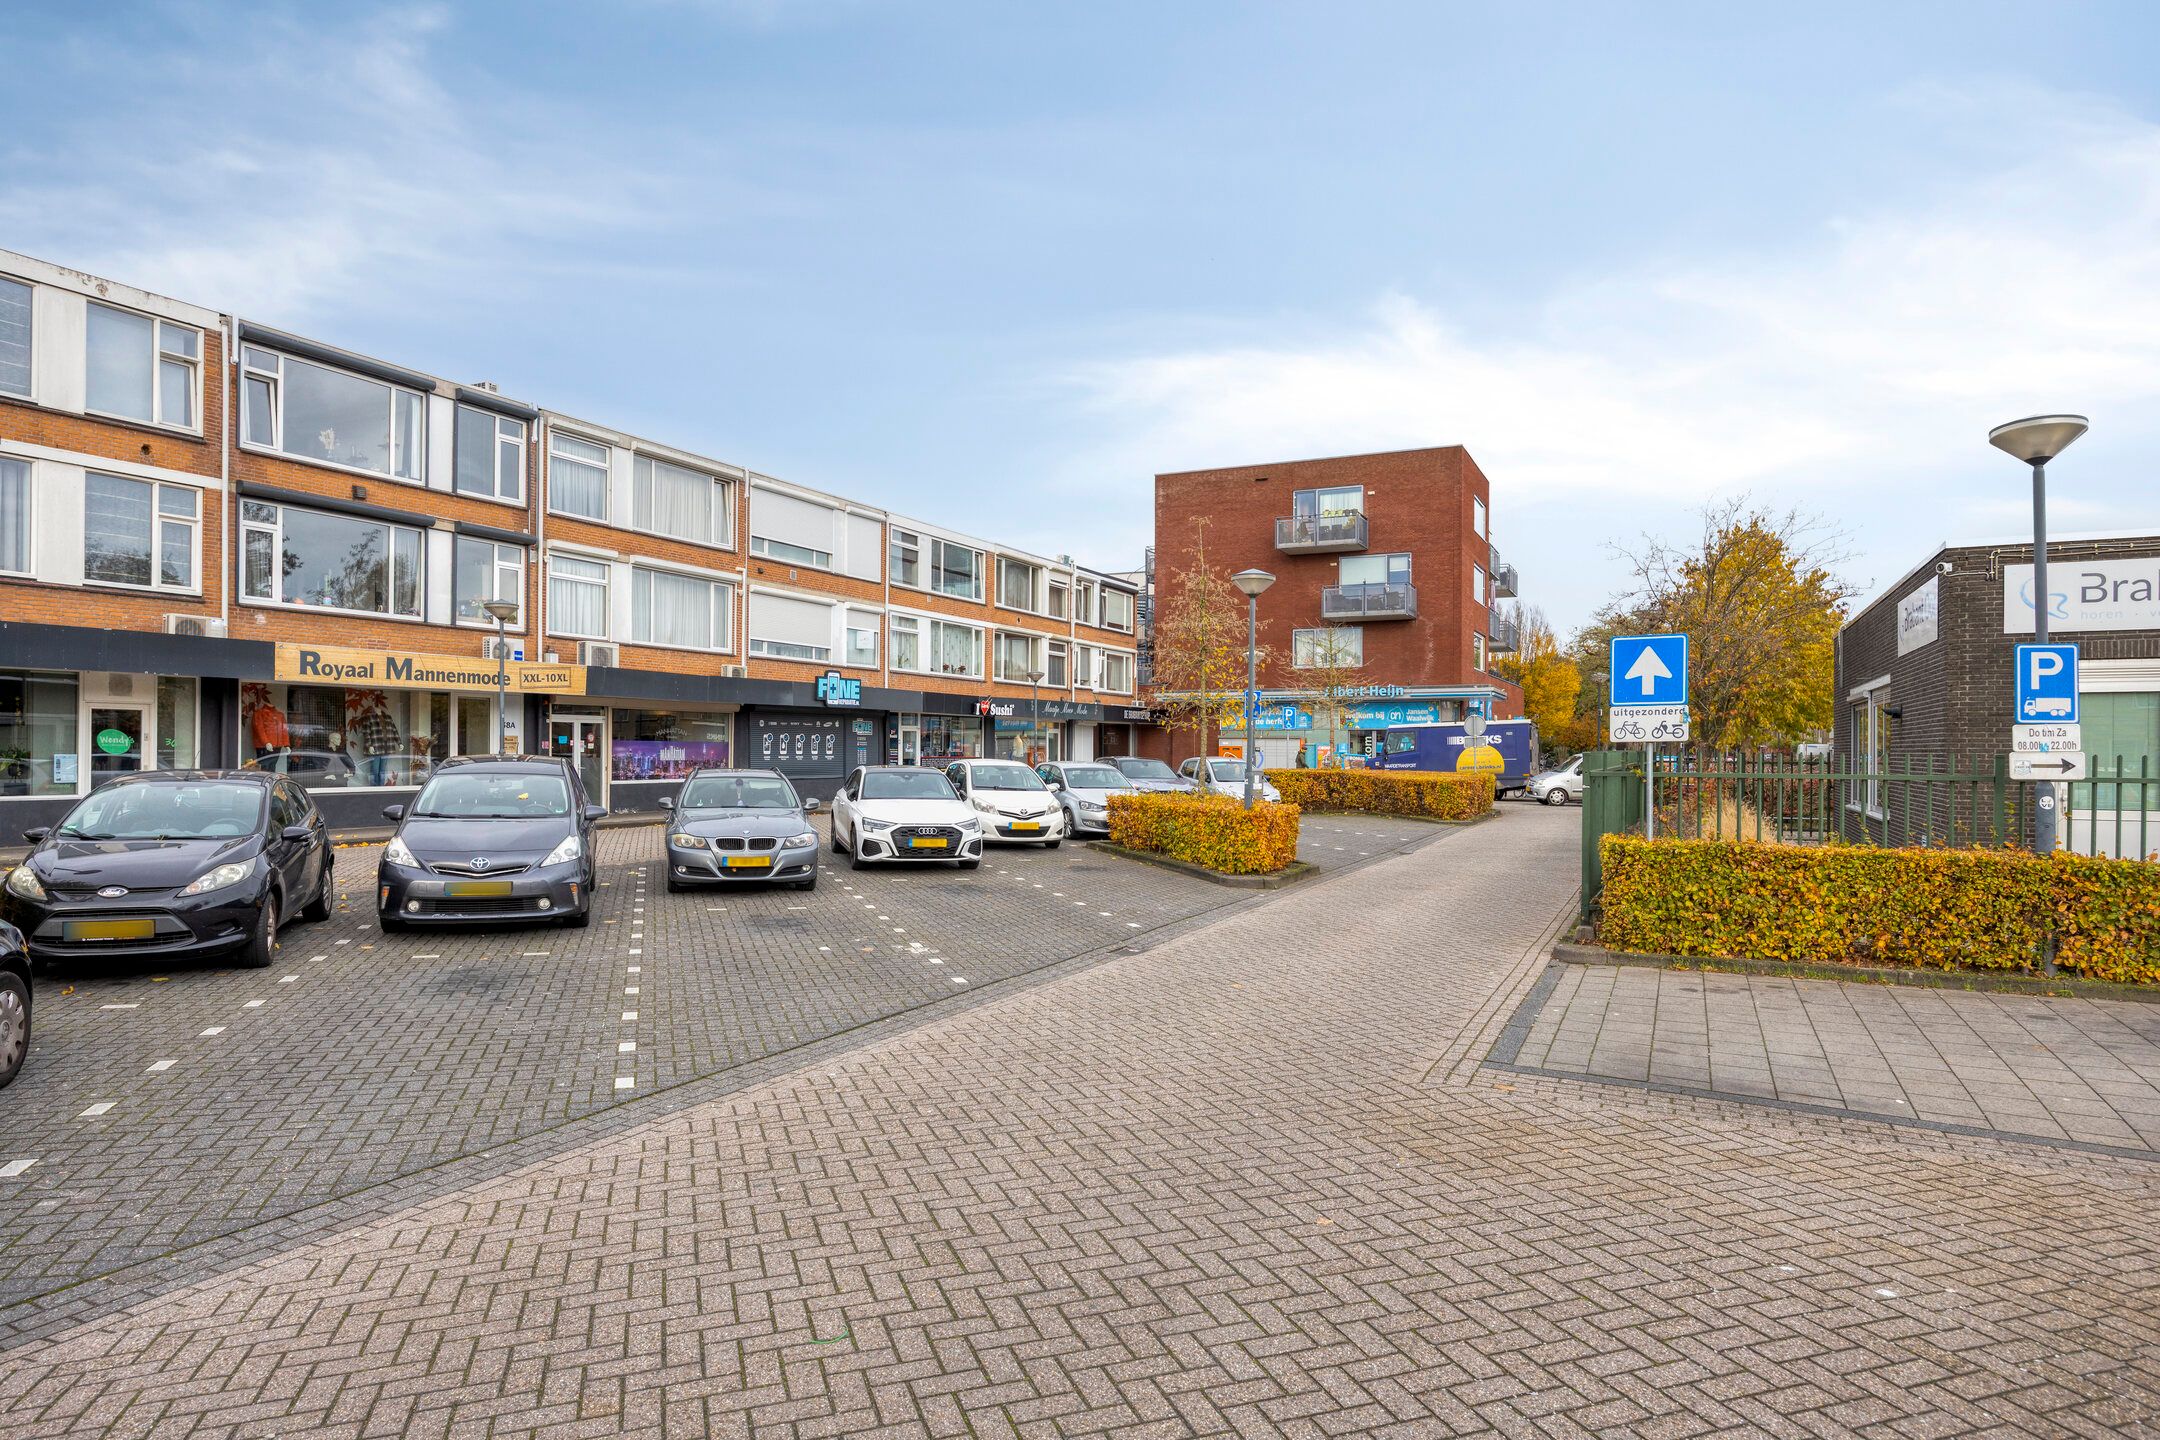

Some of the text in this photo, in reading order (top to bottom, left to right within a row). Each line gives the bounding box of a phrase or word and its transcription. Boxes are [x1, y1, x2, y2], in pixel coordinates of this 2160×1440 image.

[2081, 569, 2160, 603] Bra
[2081, 610, 2123, 620] horen
[299, 650, 568, 686] Royaal Mannenmode XXL-10XL
[2030, 651, 2064, 690] P
[1369, 684, 1404, 698] Heijn
[975, 703, 1013, 716] I Sushi
[1285, 709, 1293, 720] P
[1614, 708, 1685, 718] uitgezonderd
[1266, 717, 1283, 725] herfs
[2029, 728, 2041, 738] Do
[2056, 727, 2067, 737] Za
[99, 735, 135, 746] Wendy's
[1456, 734, 1502, 745] BKS
[2050, 741, 2077, 750] 22.00h
